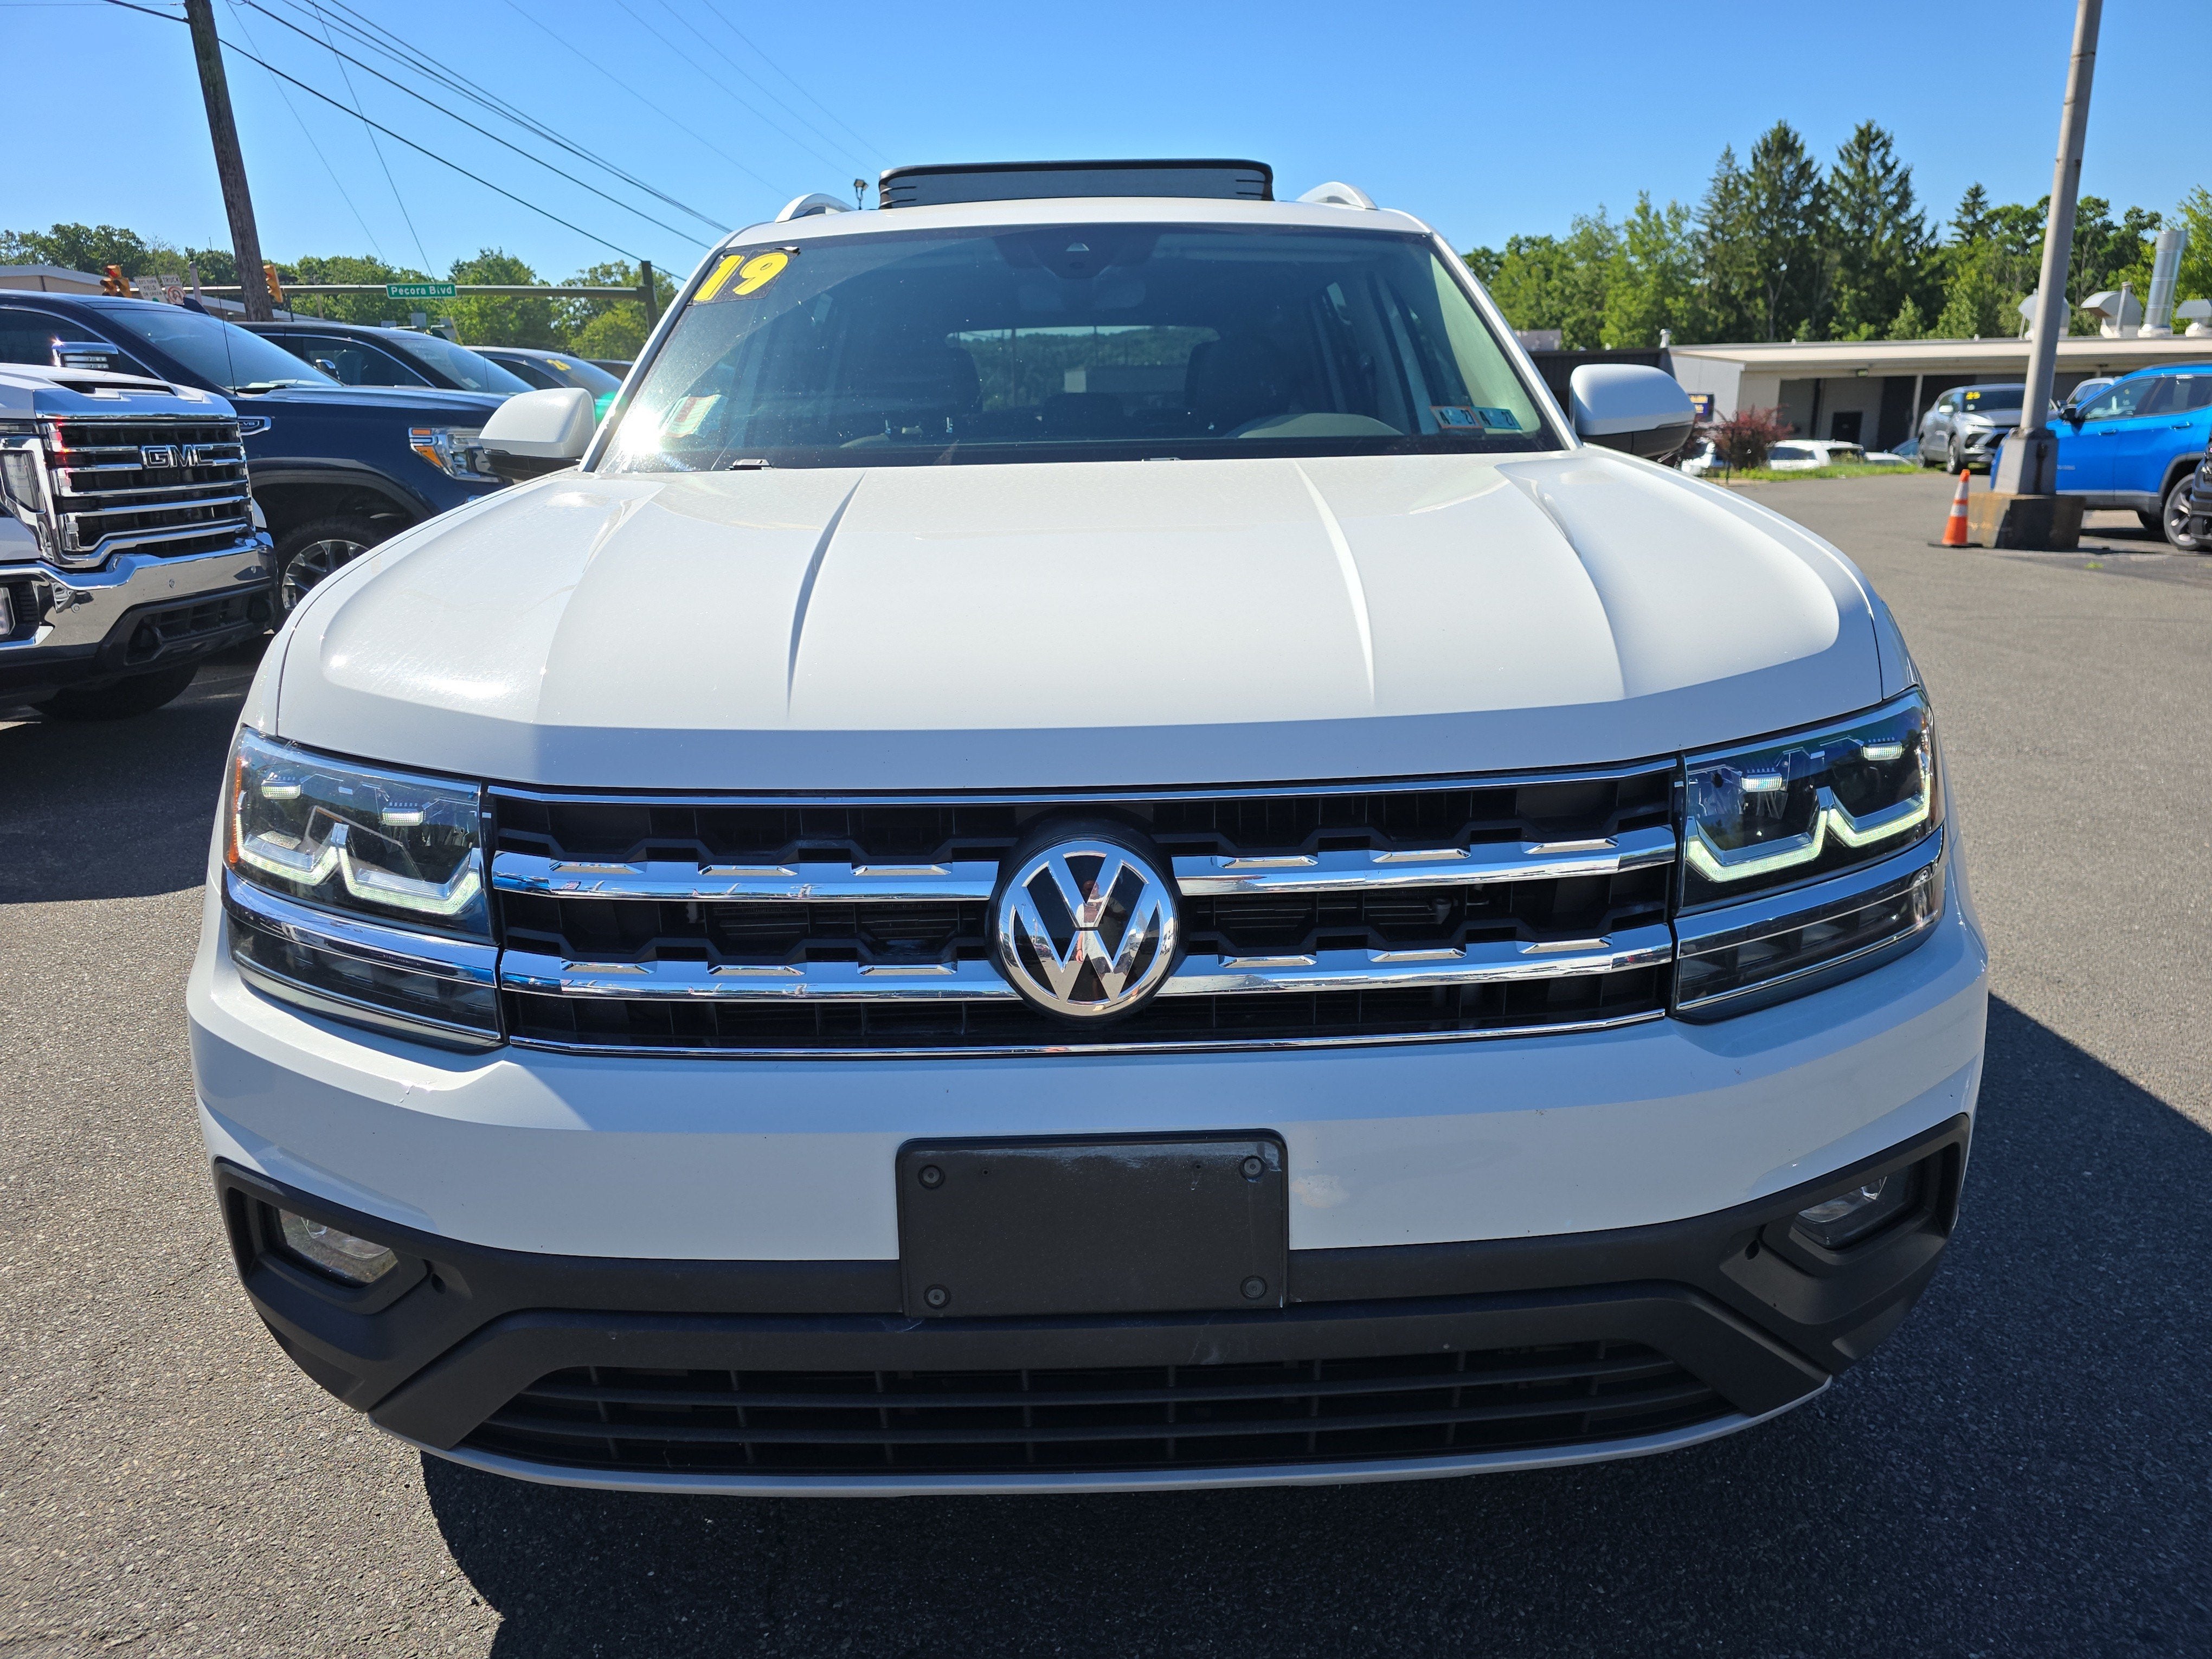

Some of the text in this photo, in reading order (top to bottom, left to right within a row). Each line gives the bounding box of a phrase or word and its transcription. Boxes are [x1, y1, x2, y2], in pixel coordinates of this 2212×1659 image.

[693, 252, 789, 302] 19
[390, 285, 452, 295] Pecora Blvd
[141, 444, 214, 469] GMC
